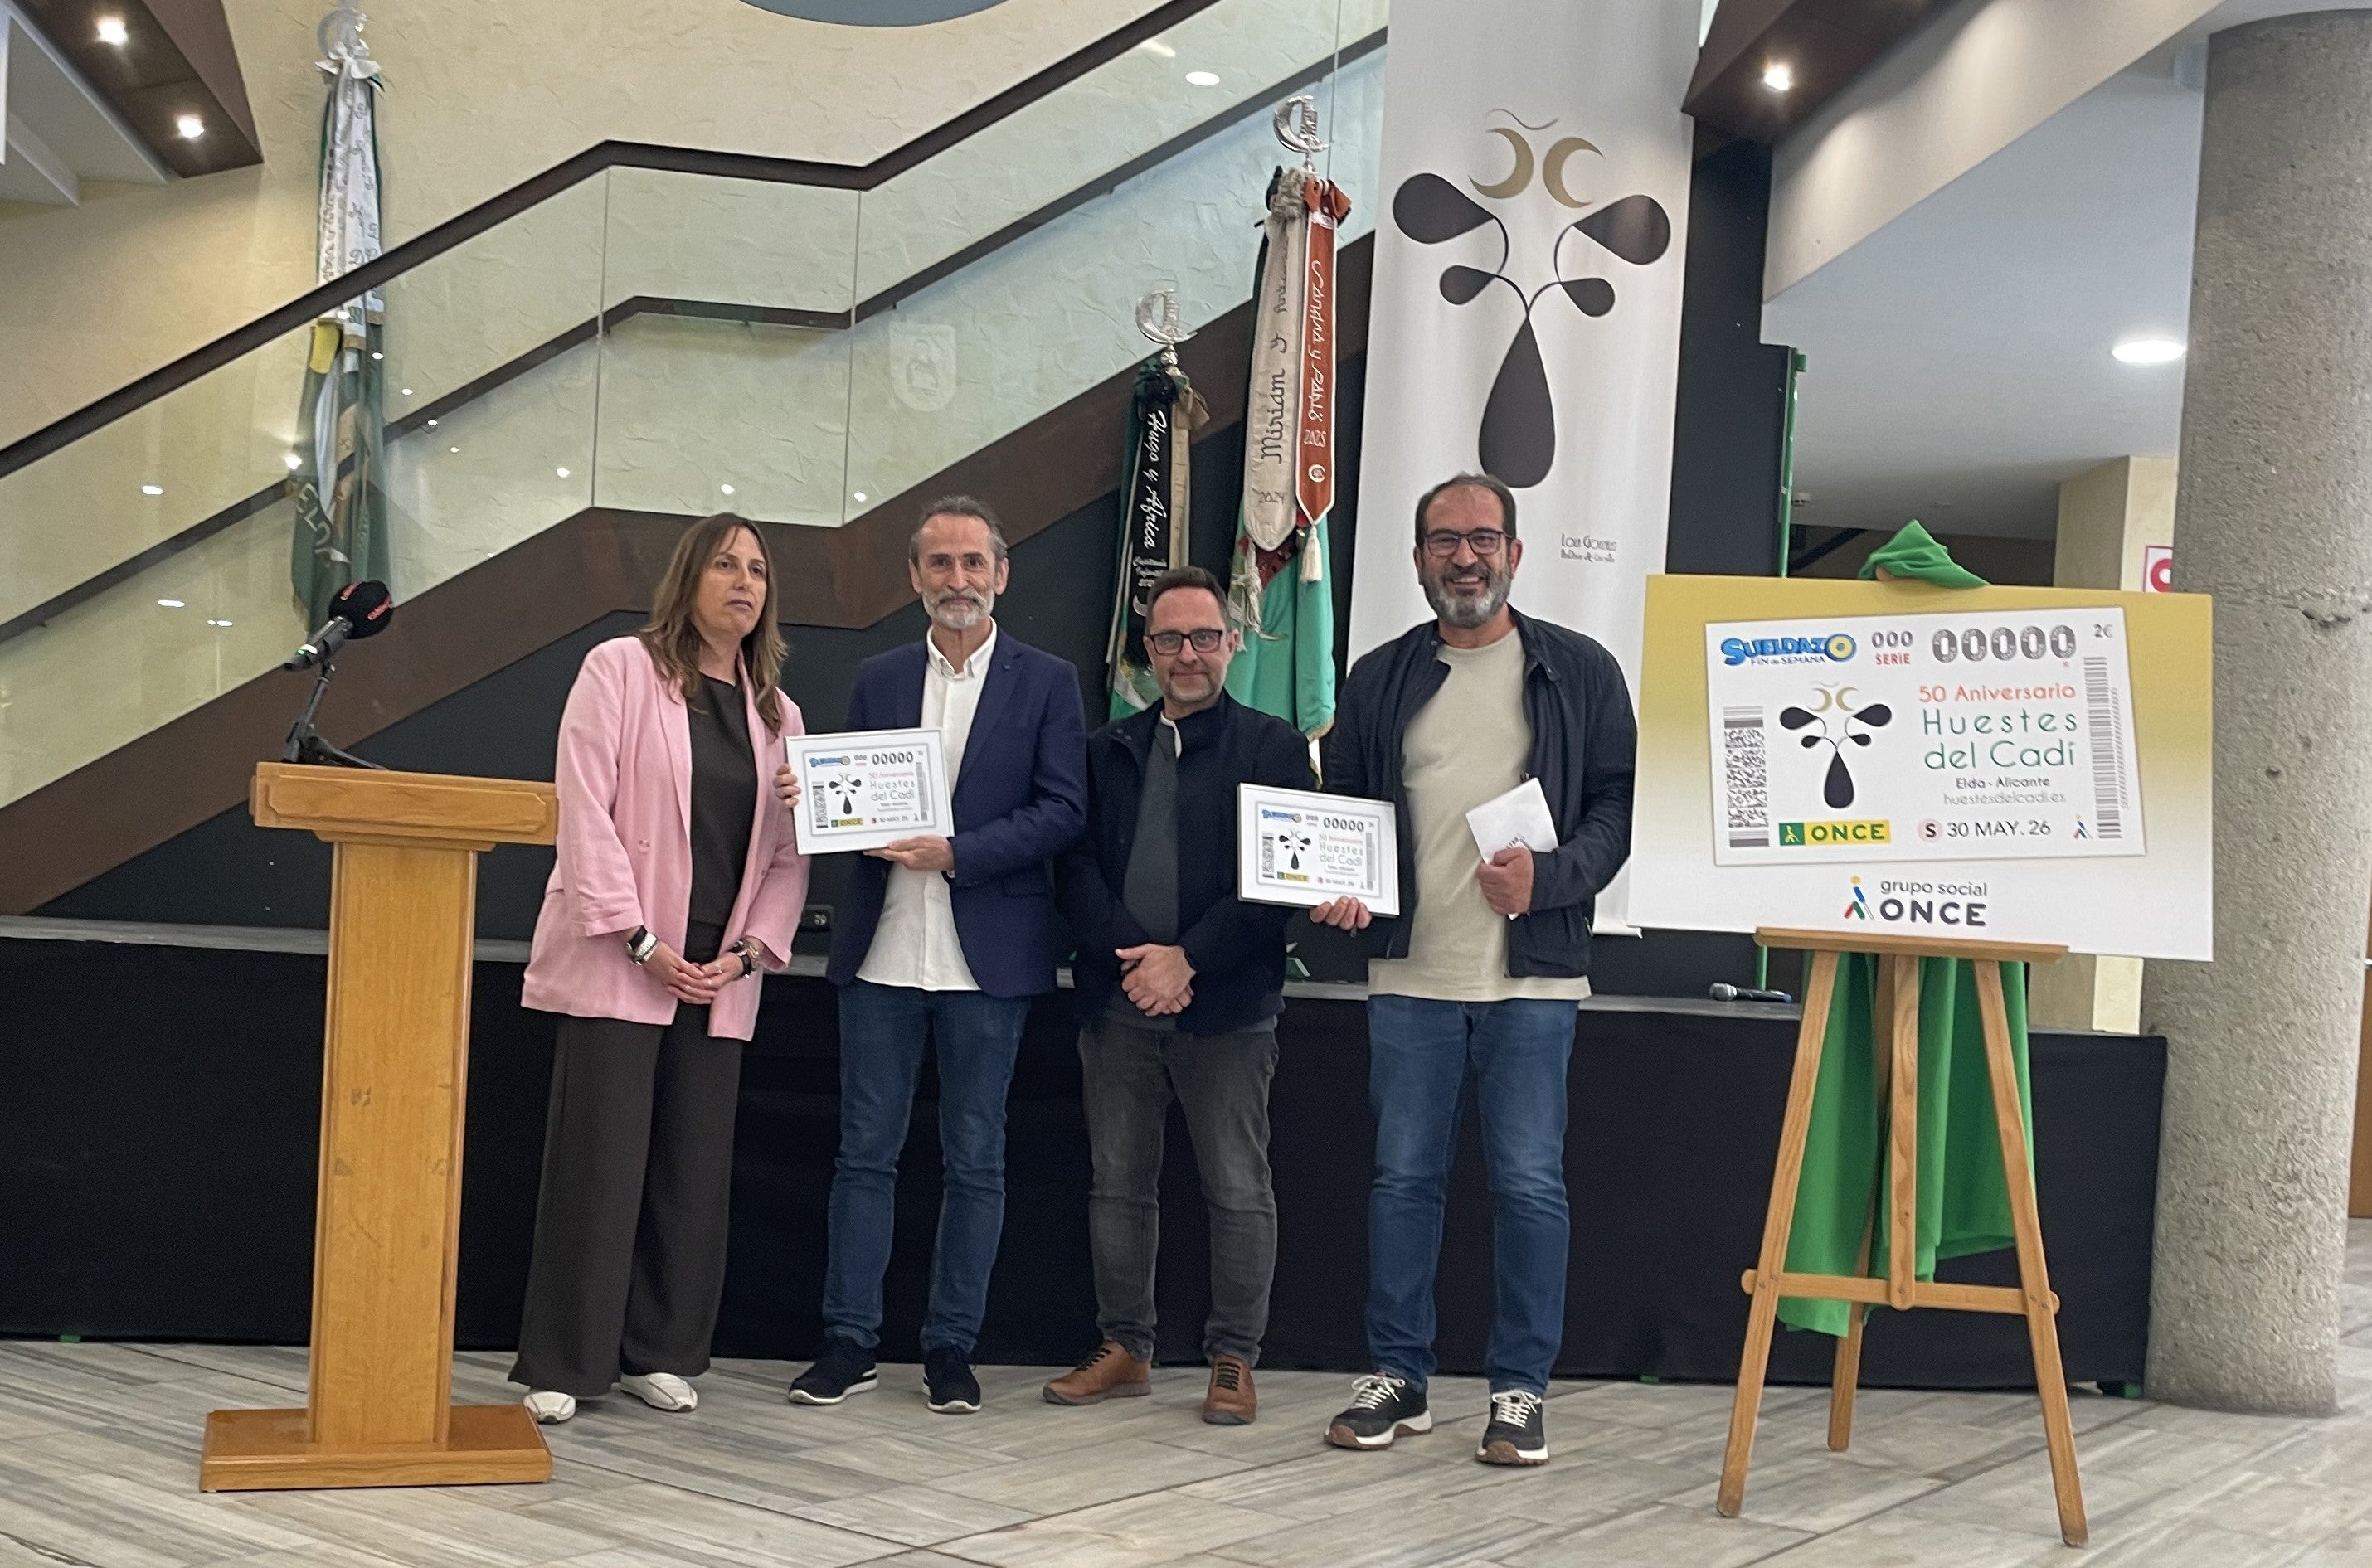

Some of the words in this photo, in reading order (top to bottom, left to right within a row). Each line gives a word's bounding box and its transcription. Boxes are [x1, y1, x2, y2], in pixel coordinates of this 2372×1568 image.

[1261, 368, 1285, 464] Miriam
[1144, 410, 1167, 462] Hugo
[1143, 468, 1159, 482] y
[1872, 631, 1913, 648] 000
[1932, 624, 2076, 663] 00000
[1721, 634, 1857, 666] SUELDAZO
[1875, 653, 1911, 665] SERIE
[1781, 655, 1825, 665] SEMANA
[1919, 685, 1947, 703] 50
[1955, 682, 2076, 702] Aniversario
[1922, 708, 2078, 735] Huestes
[872, 751, 914, 765] 00000
[1924, 741, 1976, 769] del
[1956, 777, 1986, 789] Elda
[1996, 776, 2050, 788] Alicante
[1323, 817, 1364, 833] 00000
[1811, 823, 1885, 841] ONCE
[1925, 823, 1937, 838] S
[1947, 821, 1970, 837] 30
[1975, 820, 2025, 837] MAY.
[2029, 819, 2052, 836] 26
[1880, 880, 1933, 896] grupo
[1937, 881, 1988, 896] social
[1879, 898, 1987, 927] ONCE
